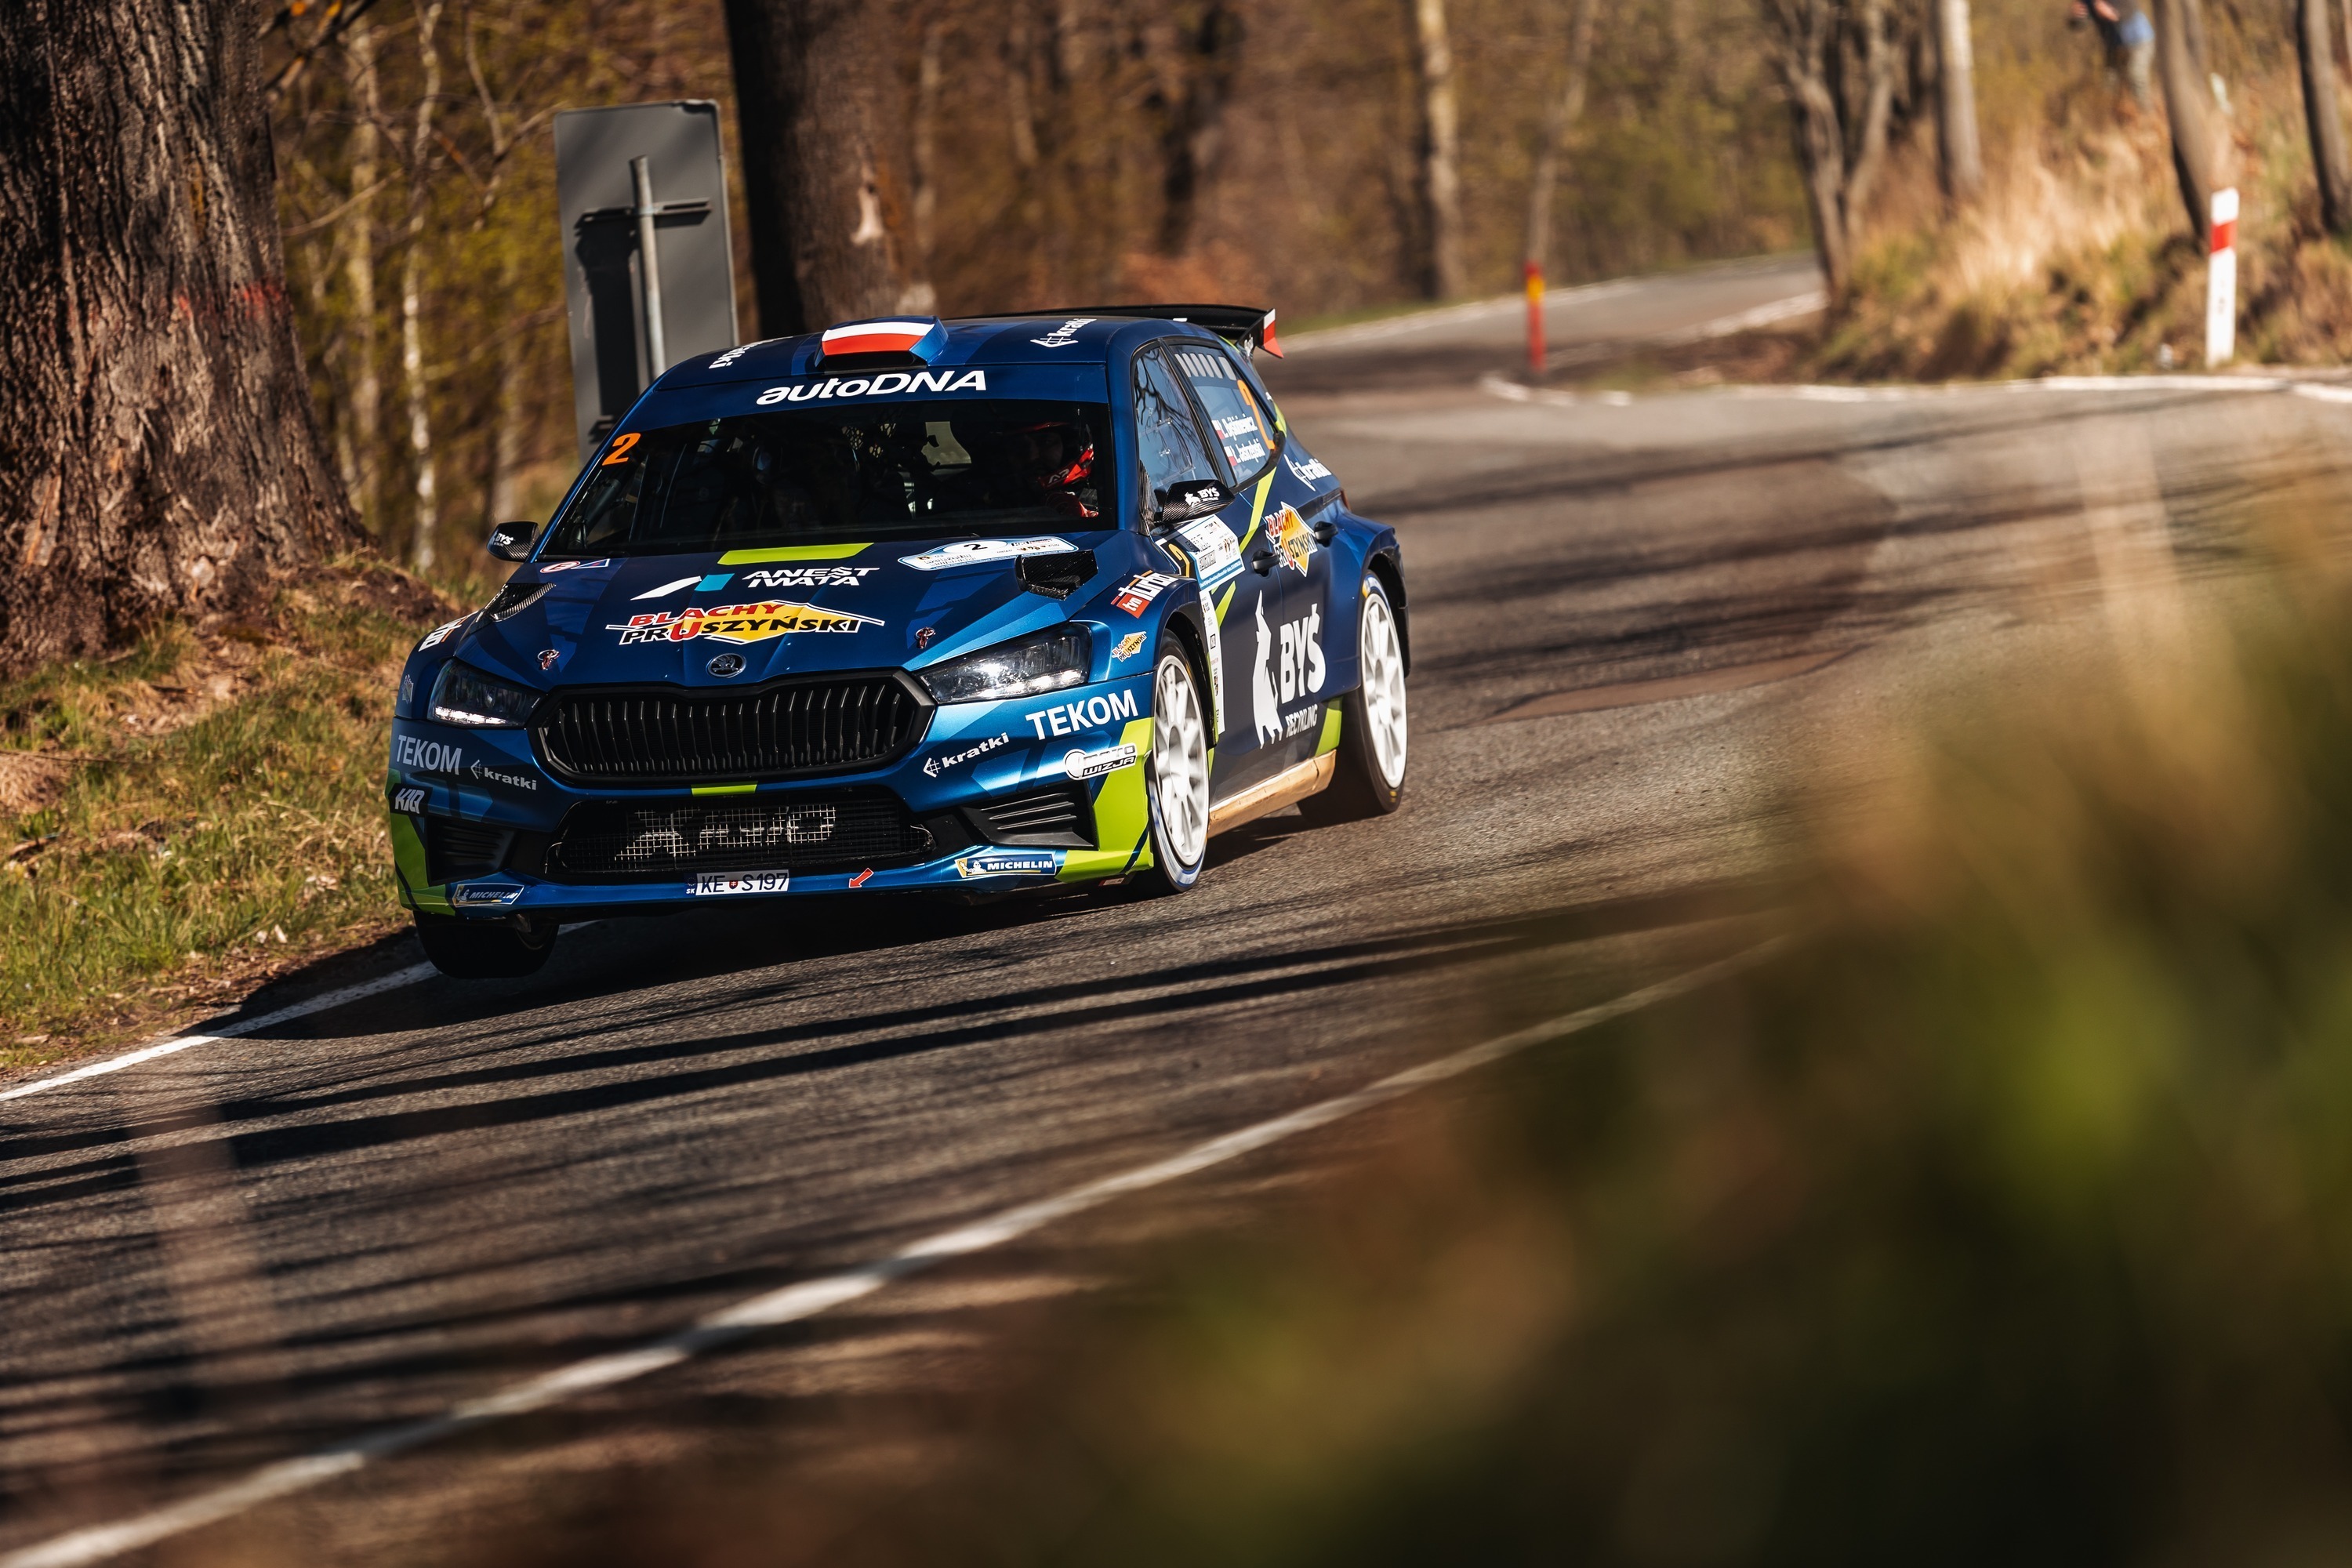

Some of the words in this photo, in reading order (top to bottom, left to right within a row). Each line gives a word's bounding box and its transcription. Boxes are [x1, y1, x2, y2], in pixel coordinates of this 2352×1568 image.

[756, 370, 987, 405] autoDNA
[1237, 379, 1276, 451] 2
[601, 433, 641, 466] 2
[1267, 510, 1294, 537] BLACHY
[742, 566, 880, 579] ANEST
[747, 575, 861, 588] IWATA
[630, 604, 786, 626] BLACHY
[1122, 597, 1143, 612] tvn
[1112, 636, 1132, 655] BLACHY
[1025, 688, 1138, 740] TEKOM
[1285, 703, 1318, 739] RECYKLING
[396, 734, 463, 775] TEKOM
[942, 731, 1010, 768] kratki
[1083, 755, 1135, 776] WIZJA
[484, 767, 537, 791] kratki
[987, 860, 1054, 870] MICHELIN
[701, 875, 726, 893] KE
[742, 872, 788, 891] S197
